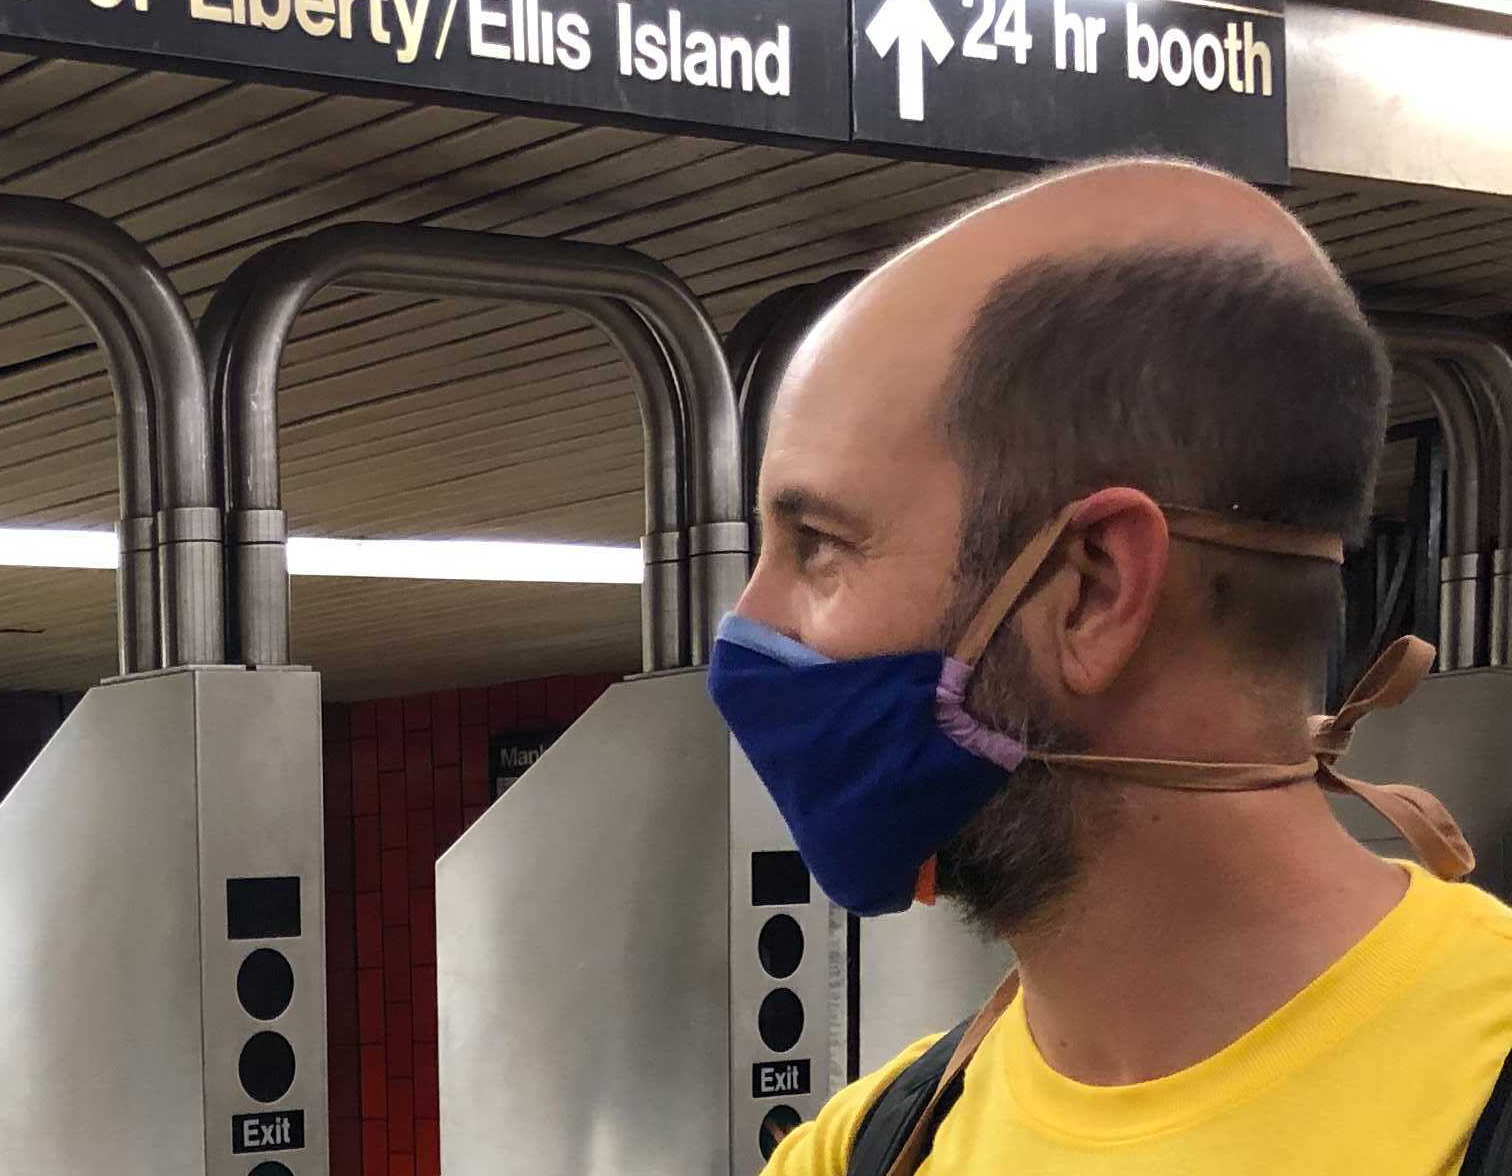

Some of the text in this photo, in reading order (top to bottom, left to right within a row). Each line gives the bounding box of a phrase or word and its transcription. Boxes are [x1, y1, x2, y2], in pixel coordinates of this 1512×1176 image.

[617, 2, 790, 96] Island
[962, 0, 1273, 96] 24 hr booth
[761, 1065, 799, 1092] Exit
[243, 1117, 290, 1147] Exit
